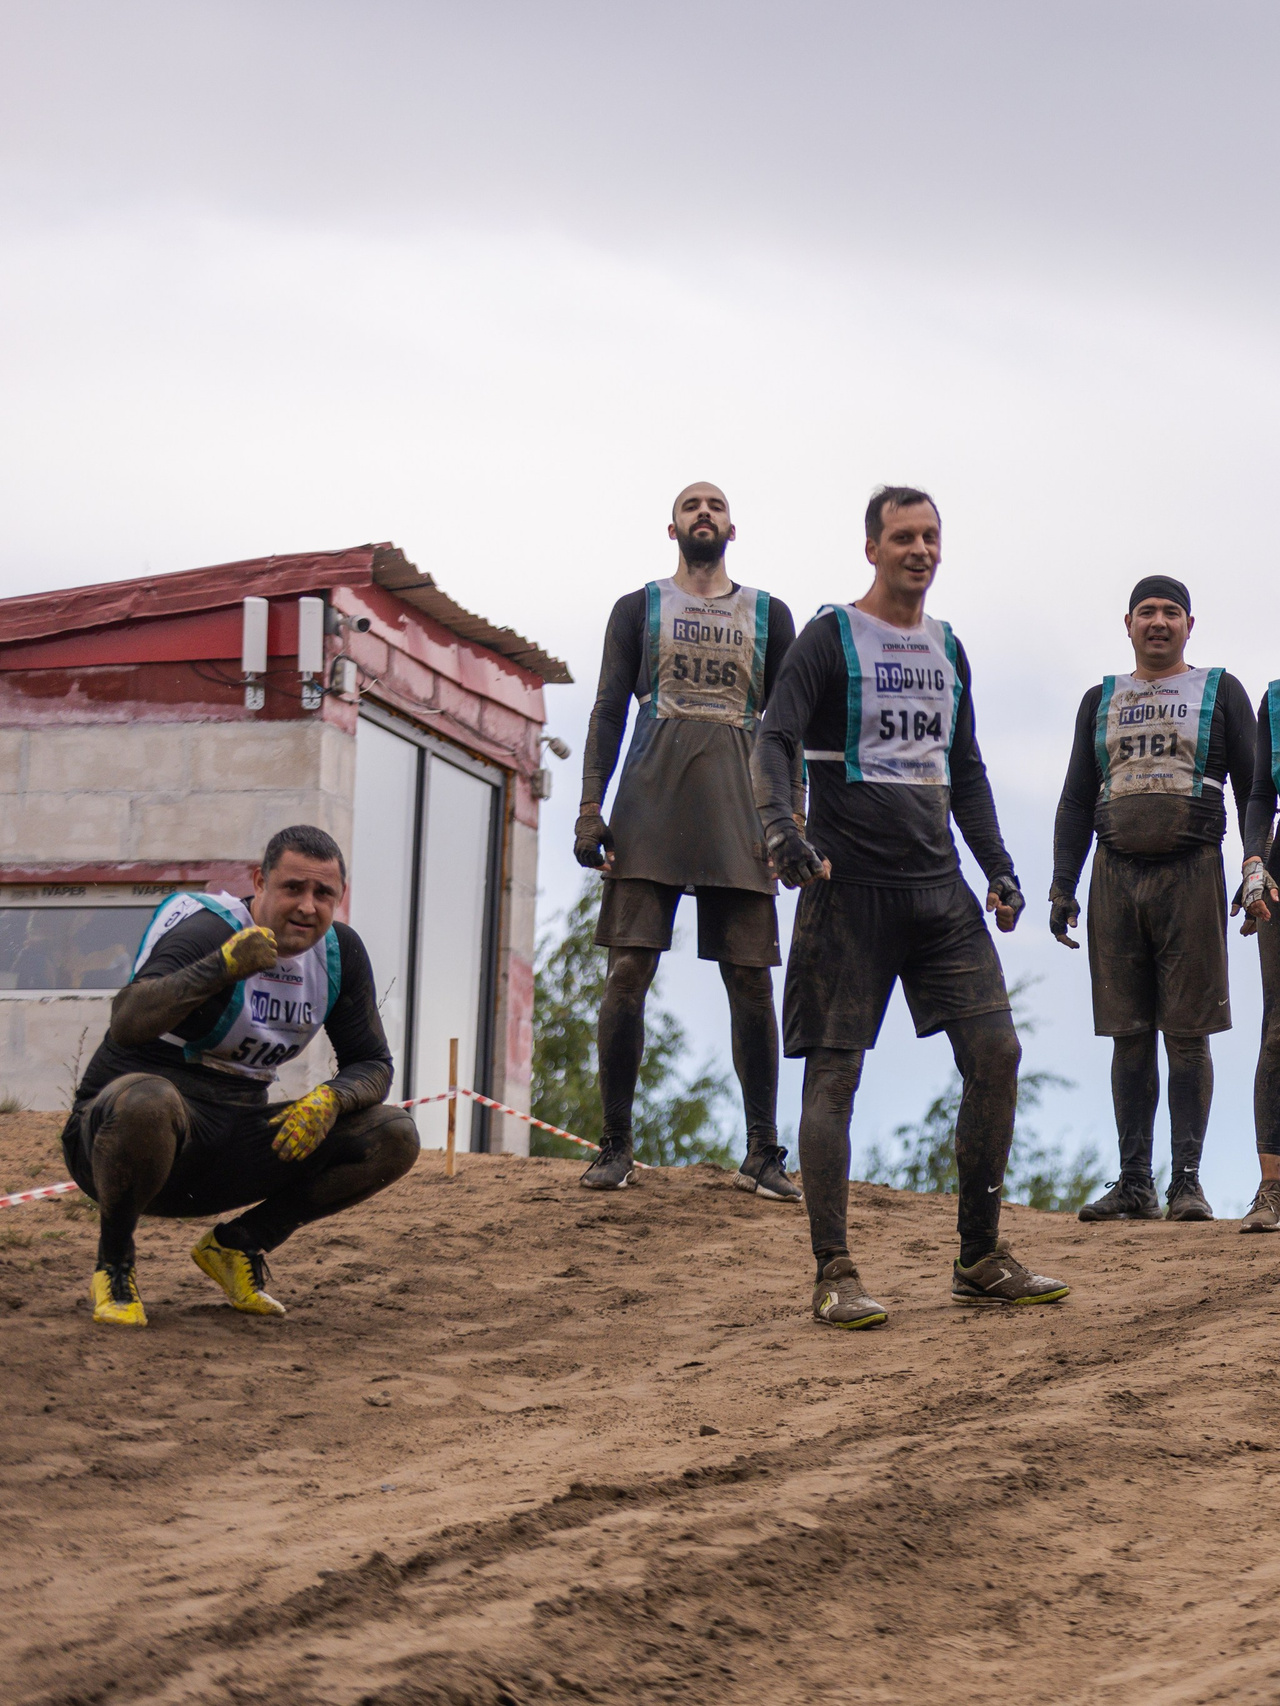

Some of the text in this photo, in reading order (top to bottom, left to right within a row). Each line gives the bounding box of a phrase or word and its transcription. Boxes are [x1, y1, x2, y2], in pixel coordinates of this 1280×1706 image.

[674, 619, 743, 646] RODVIG
[882, 643, 906, 651] ГОНКА
[673, 653, 738, 687] 5156
[875, 663, 945, 692] RODVIG
[879, 709, 942, 742] 5164
[1120, 704, 1188, 724] RODVIG
[1119, 732, 1178, 760] 5161
[251, 990, 312, 1024] RODVIG
